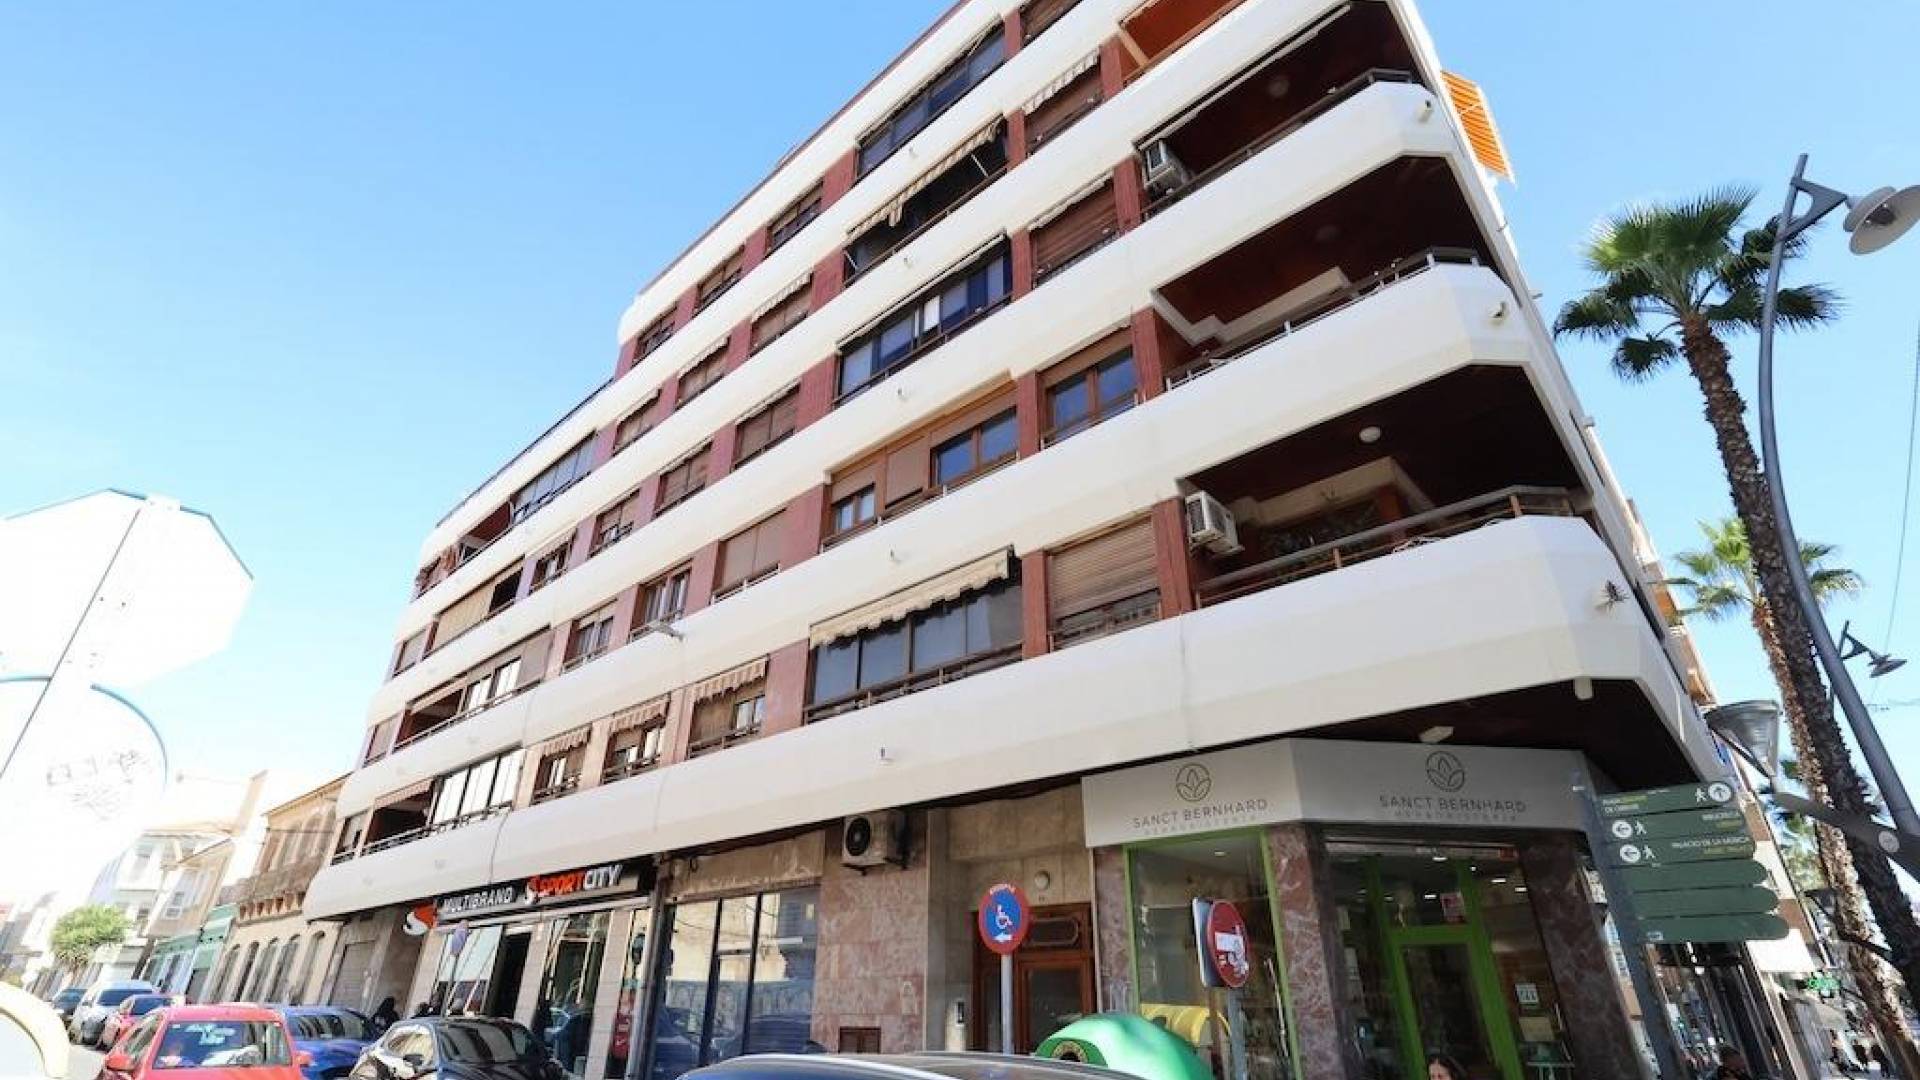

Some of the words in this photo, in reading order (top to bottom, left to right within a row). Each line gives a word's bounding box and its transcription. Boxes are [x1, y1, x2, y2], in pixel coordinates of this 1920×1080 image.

[1133, 811, 1178, 829] SANCT
[1184, 799, 1268, 821] BERNHARD
[1379, 795, 1432, 809] SANCT
[1439, 798, 1527, 813] BERNHARD
[443, 887, 515, 912] MULTIBRAND
